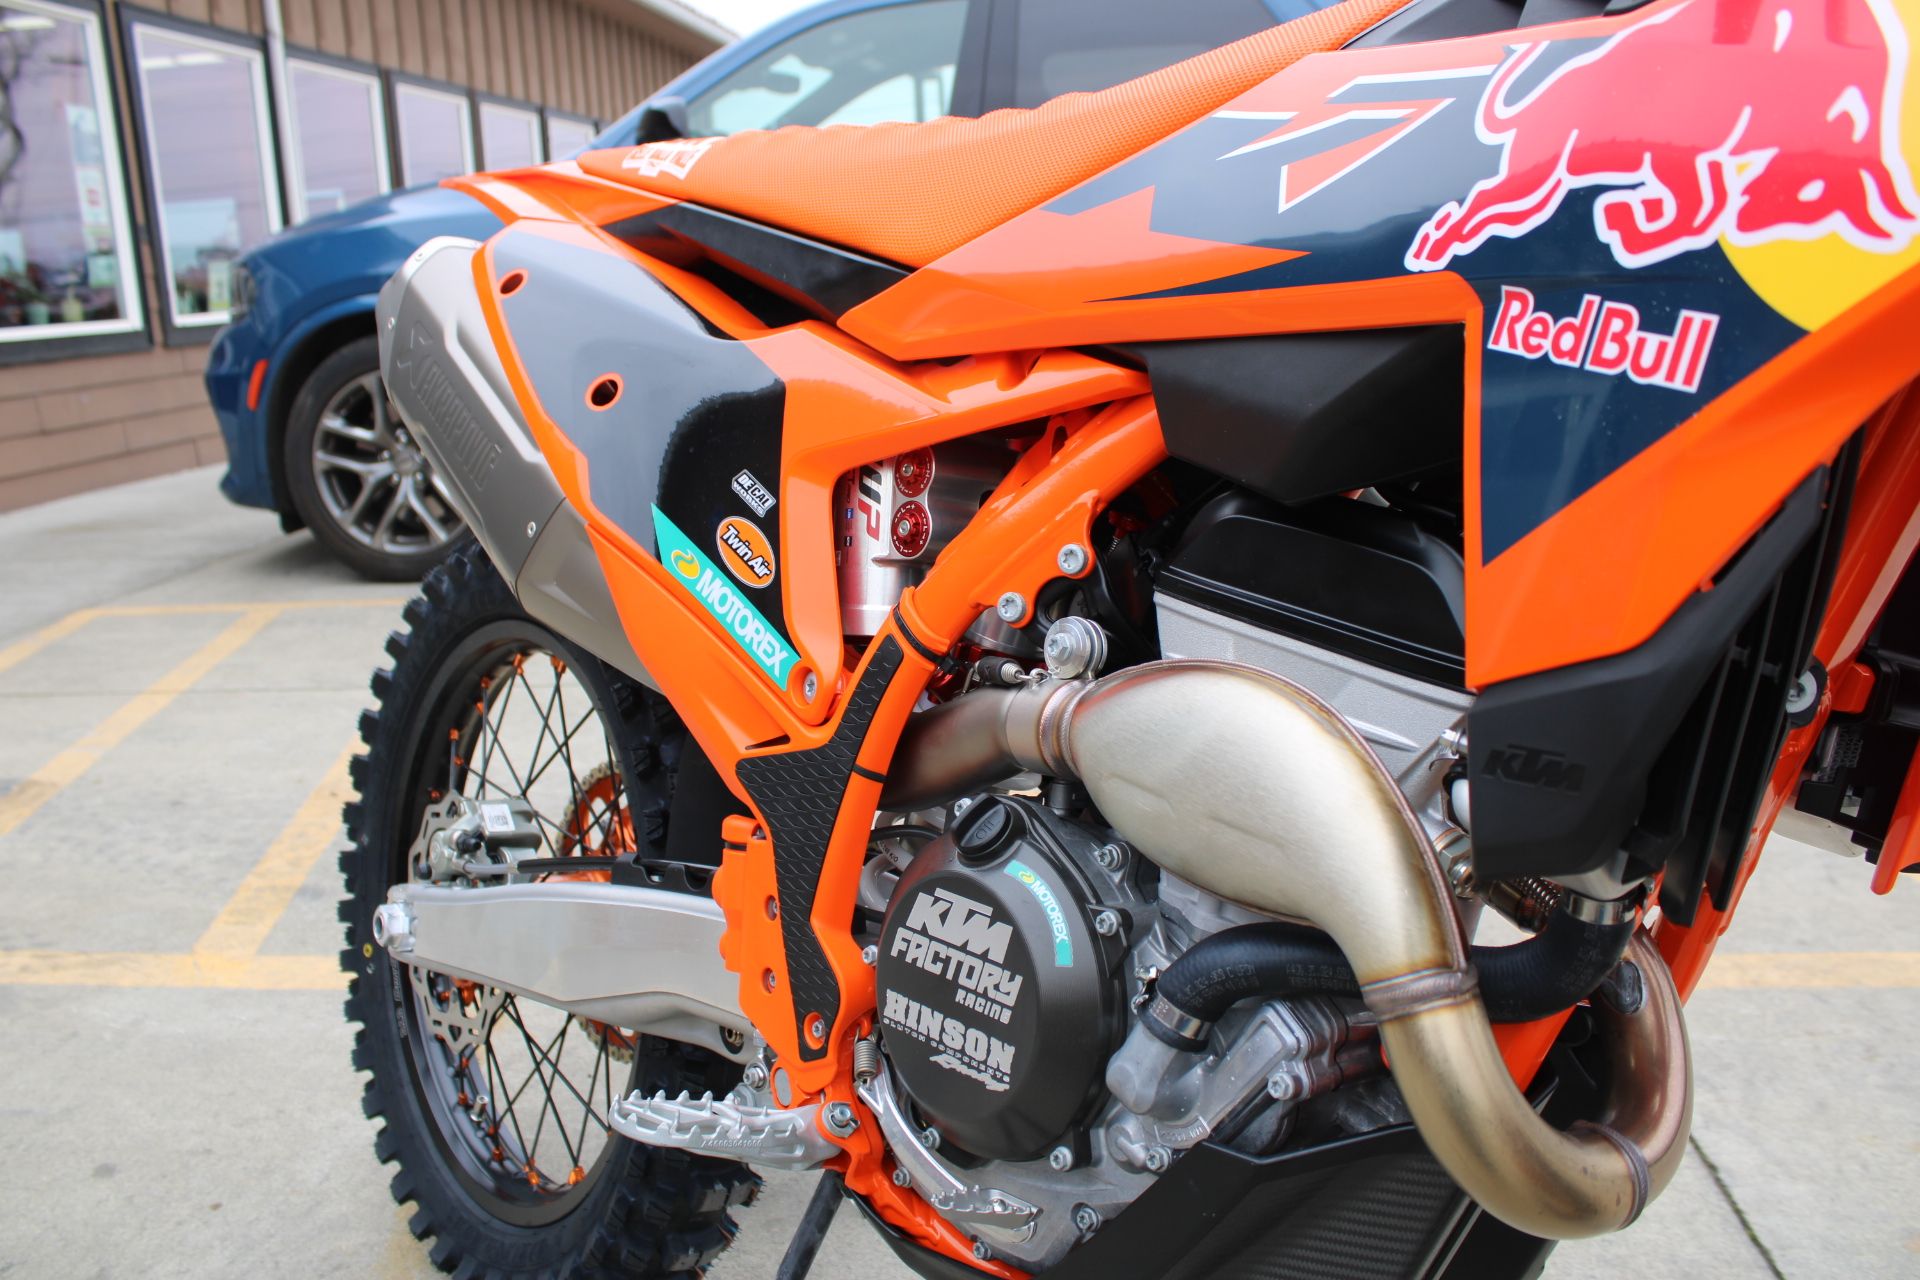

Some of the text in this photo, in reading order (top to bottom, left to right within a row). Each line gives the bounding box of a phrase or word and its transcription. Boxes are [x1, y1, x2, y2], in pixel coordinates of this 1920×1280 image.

[1488, 285, 1720, 393] Red Bull
[733, 481, 764, 514] WORKS
[721, 524, 771, 578] Twin Air
[696, 568, 790, 677] MOTOREX
[1482, 743, 1587, 793] KTM
[905, 887, 1013, 964] KTM
[1031, 880, 1069, 944] MOTOREX
[890, 926, 1023, 1007] FACTORY
[883, 989, 1016, 1074] HINSON
[955, 989, 1011, 1024] RACING
